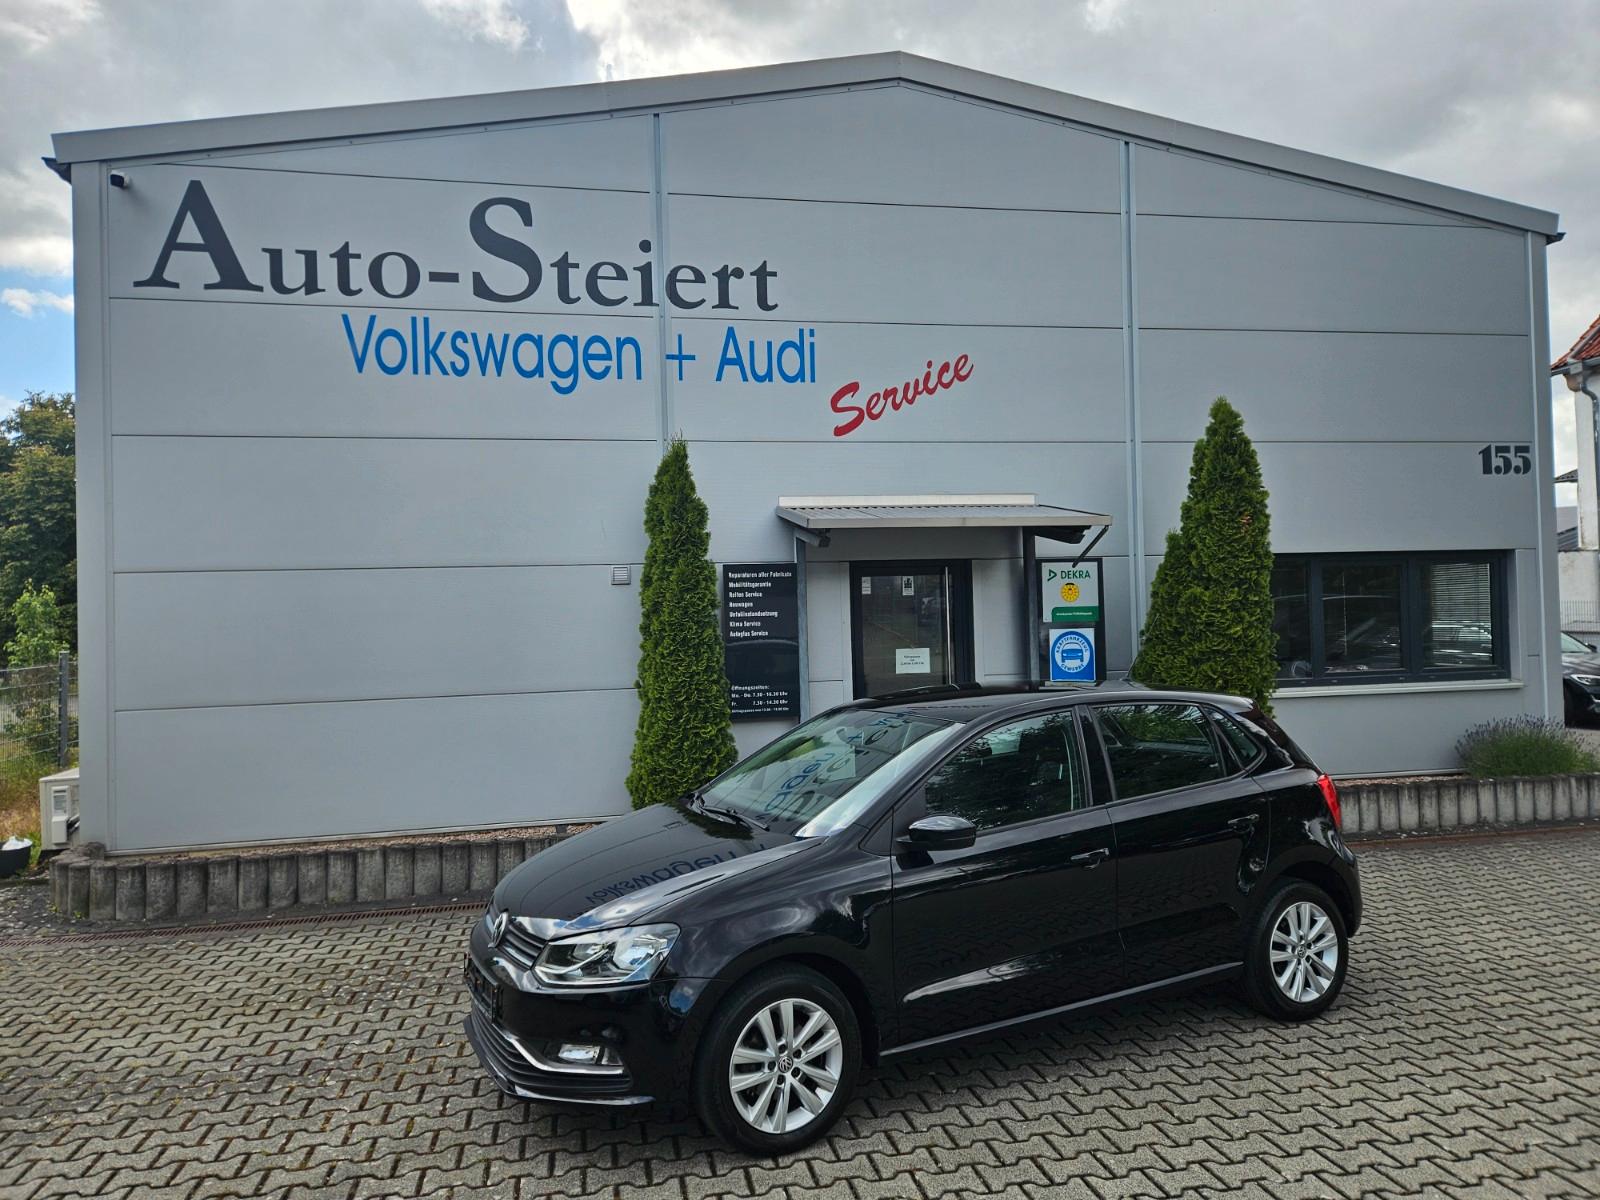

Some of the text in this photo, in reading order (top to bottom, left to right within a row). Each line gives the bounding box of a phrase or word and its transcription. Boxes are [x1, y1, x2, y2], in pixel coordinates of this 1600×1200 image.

[133, 179, 778, 312] Auto-Steiert
[341, 313, 816, 395] Volkswagen + Audi
[830, 353, 974, 437] Service
[1479, 444, 1532, 475] 155
[1060, 570, 1091, 579] DEKRA
